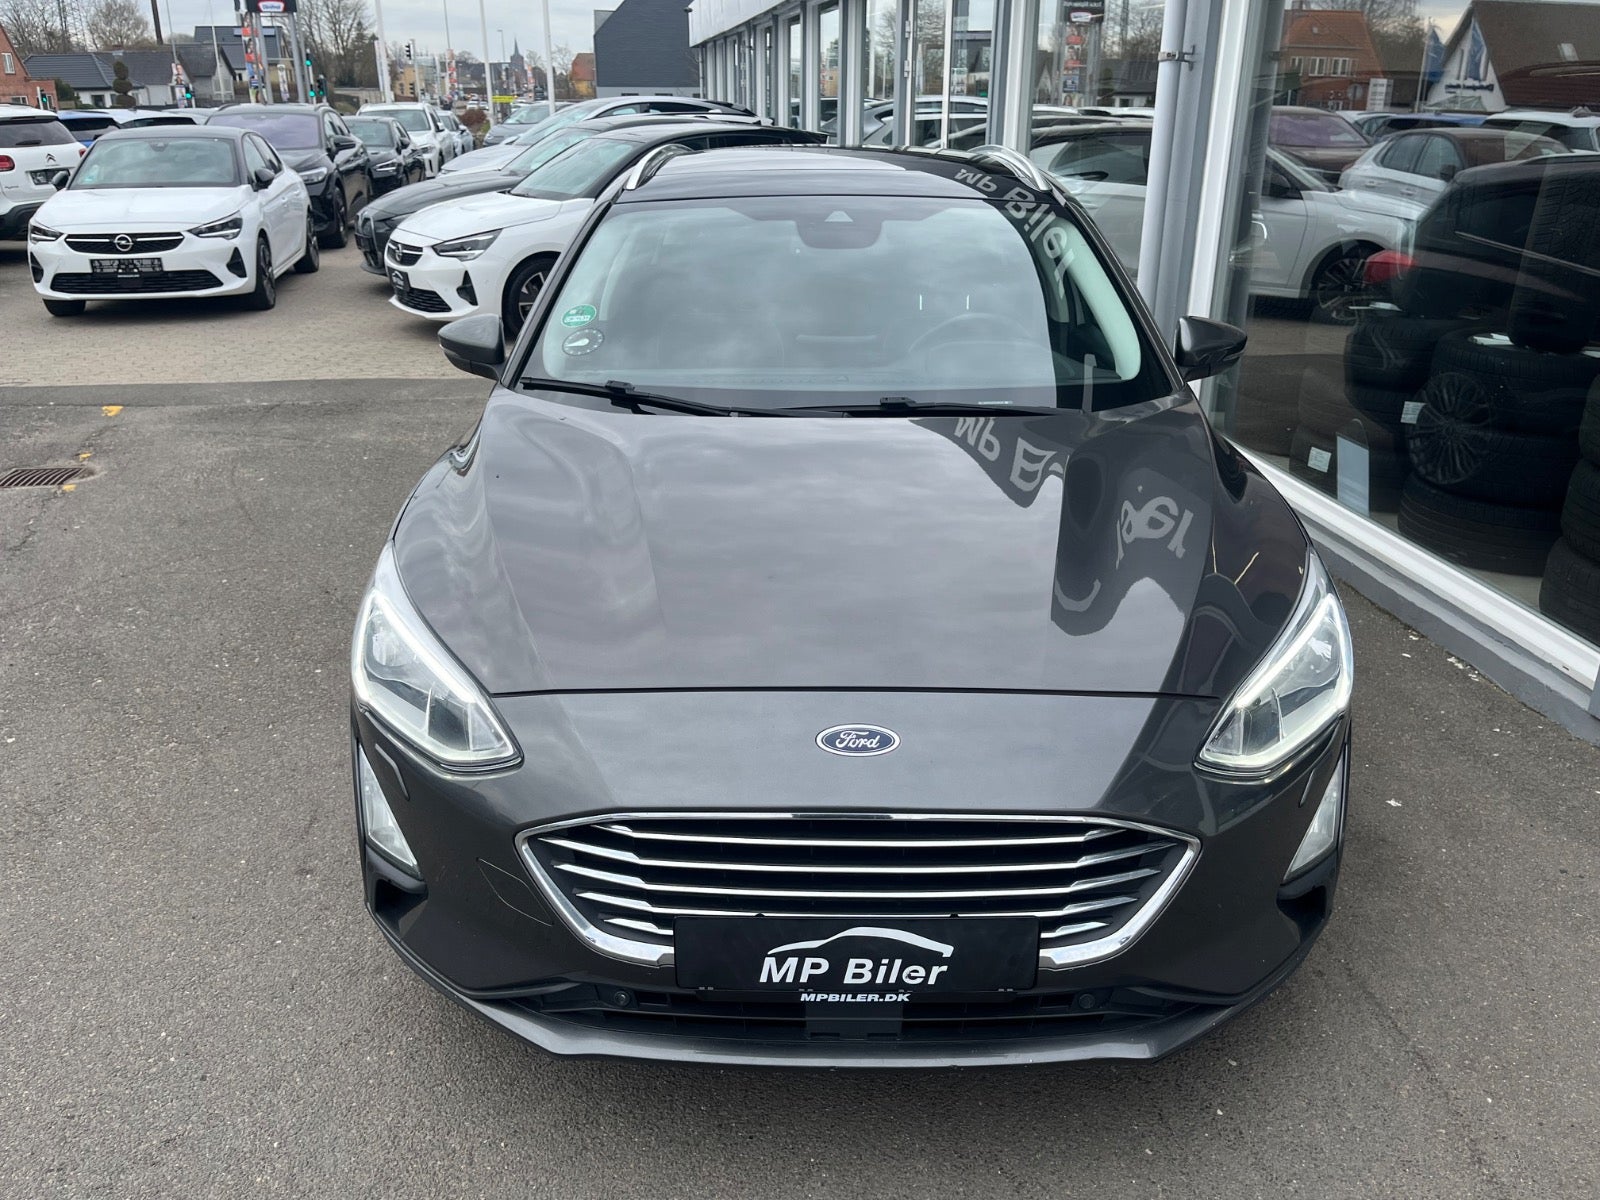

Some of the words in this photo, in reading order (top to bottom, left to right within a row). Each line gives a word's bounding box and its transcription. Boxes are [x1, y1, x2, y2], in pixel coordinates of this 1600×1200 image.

[835, 730, 881, 748] Ford
[759, 957, 830, 983] MP
[843, 958, 948, 985] Biler
[800, 993, 911, 1002] MPBILER.DK
